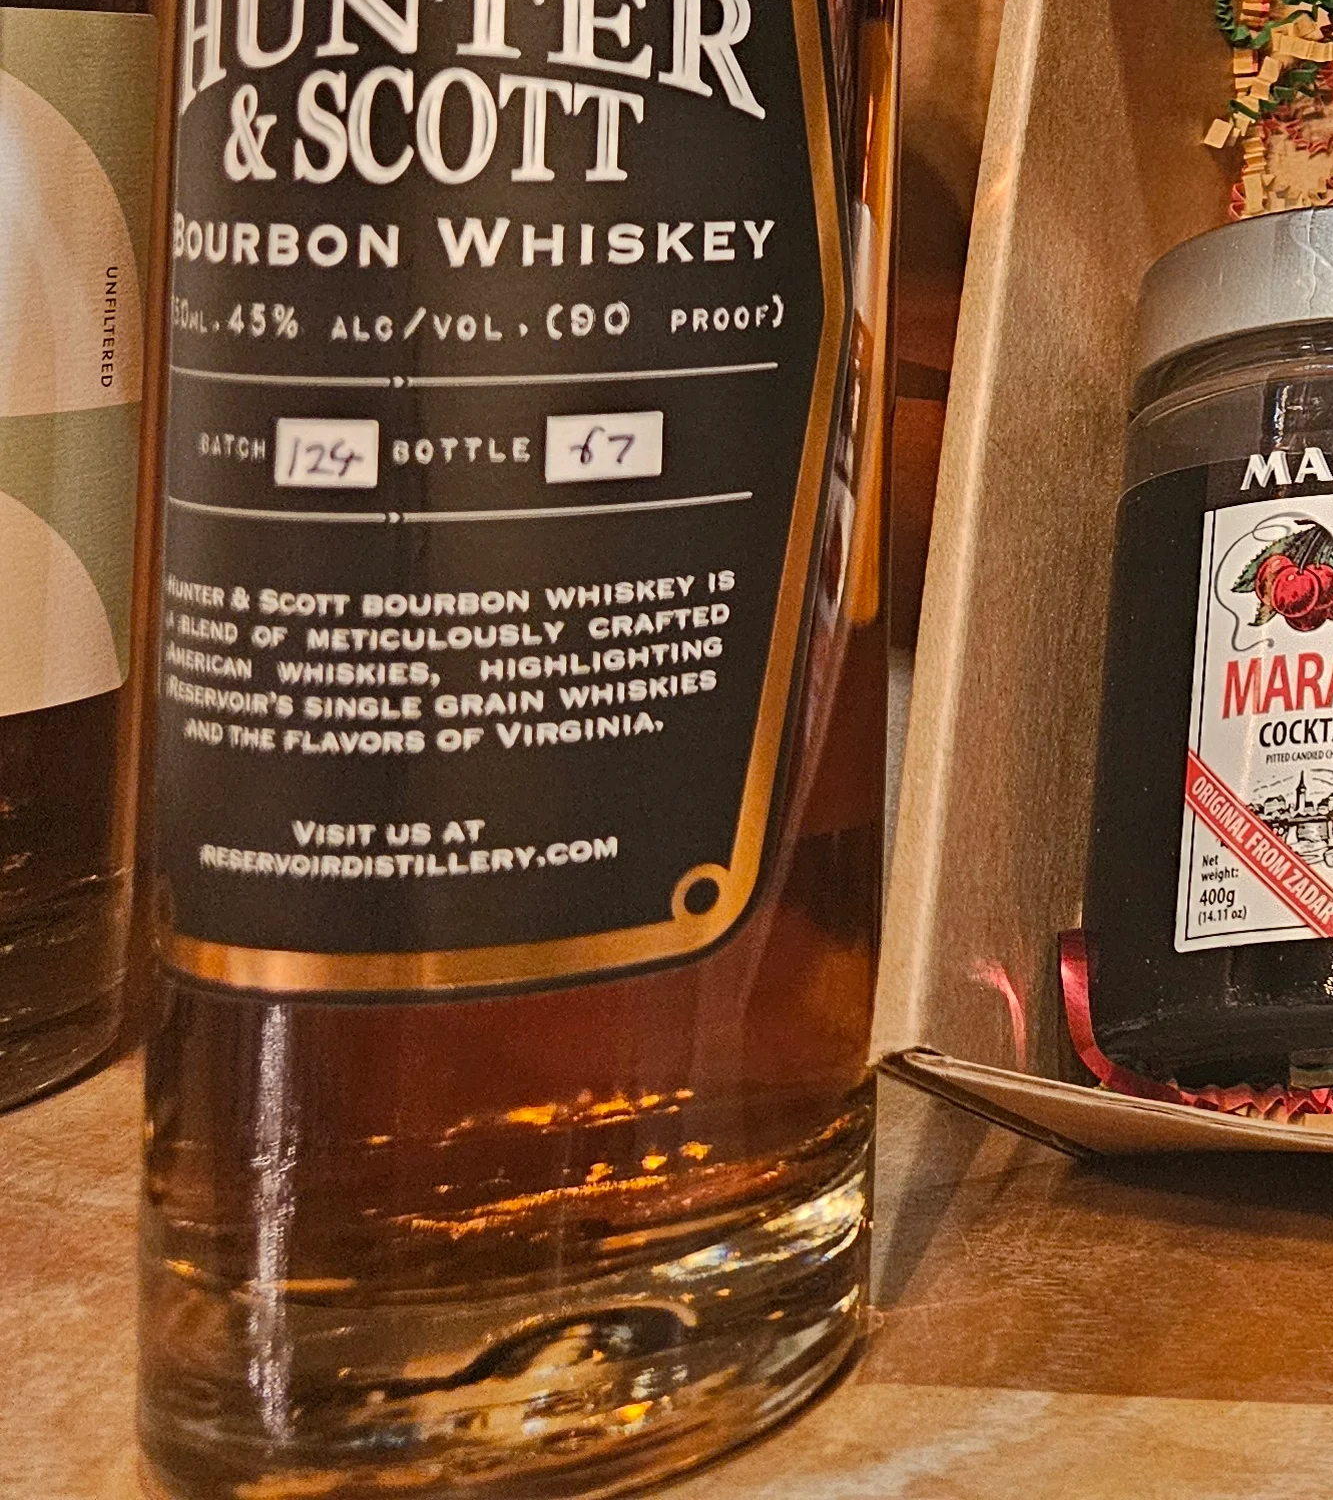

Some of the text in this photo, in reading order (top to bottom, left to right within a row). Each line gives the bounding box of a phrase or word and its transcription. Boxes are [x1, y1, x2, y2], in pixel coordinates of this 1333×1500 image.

[222, 64, 644, 185] & SCOTT
[173, 212, 776, 268] BOURBON WHISKEY
[101, 266, 119, 388] UNFILTERED
[670, 293, 785, 334] PROOF)
[200, 431, 267, 462] BATCH
[392, 436, 531, 466] BOTTLE
[167, 569, 736, 618] HUNTER & SCOTT BOURBON WHISKEY IS
[178, 614, 239, 645] BLEND
[251, 624, 288, 649] OF
[307, 620, 565, 651] METICULOUSLY
[588, 602, 731, 641] CRAFTED
[166, 635, 724, 690] AMERICAN WHISKIES, HIGHLIGHTING
[303, 695, 423, 720] SINGLE
[433, 689, 544, 719] GRAIN
[558, 668, 718, 711] WHISKIES
[183, 718, 224, 746] AND
[228, 723, 277, 750] THE
[283, 729, 426, 754] FLAVORS
[435, 727, 485, 753] OF
[1265, 751, 1291, 764] PITTED
[1291, 749, 1325, 762] CANDIED
[291, 818, 486, 847] VISIT US AT
[1190, 775, 1252, 844] ORIGINAL
[1244, 830, 1293, 882] FROM
[199, 835, 619, 879] RESERVOIRDISTILLERY.COM
[1200, 867, 1240, 883] weight:
[1202, 855, 1219, 869] Net
[1198, 905, 1248, 926] (14.11 oz)
[1199, 887, 1236, 908] 400g
